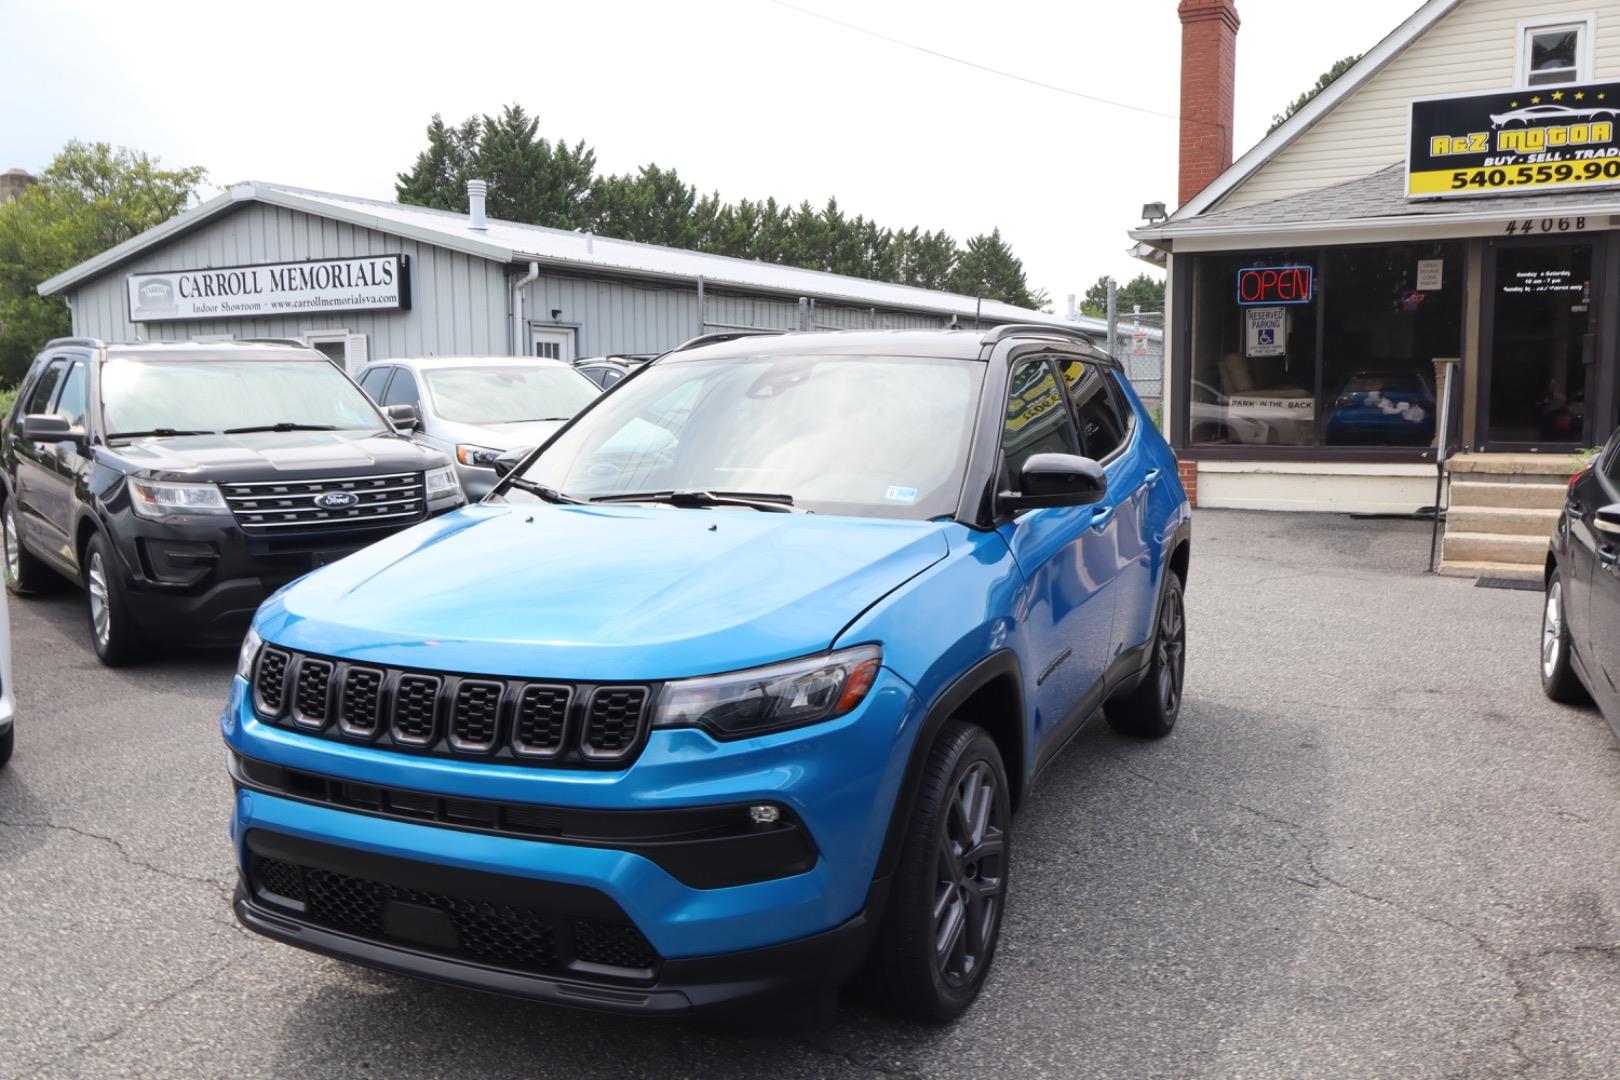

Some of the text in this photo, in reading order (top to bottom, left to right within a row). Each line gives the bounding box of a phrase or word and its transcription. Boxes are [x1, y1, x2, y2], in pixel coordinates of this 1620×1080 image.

[1484, 147, 1620, 167] BUY SELL TRAD
[178, 260, 394, 299] CARROLL MEMORIALS
[1241, 268, 1310, 301] OPEN
[192, 293, 398, 314] Indoor Showroom www.carrollmemorialsva.com
[1251, 320, 1281, 329] PARKING
[1231, 400, 1255, 408] PARK
[1288, 401, 1313, 409] BACK
